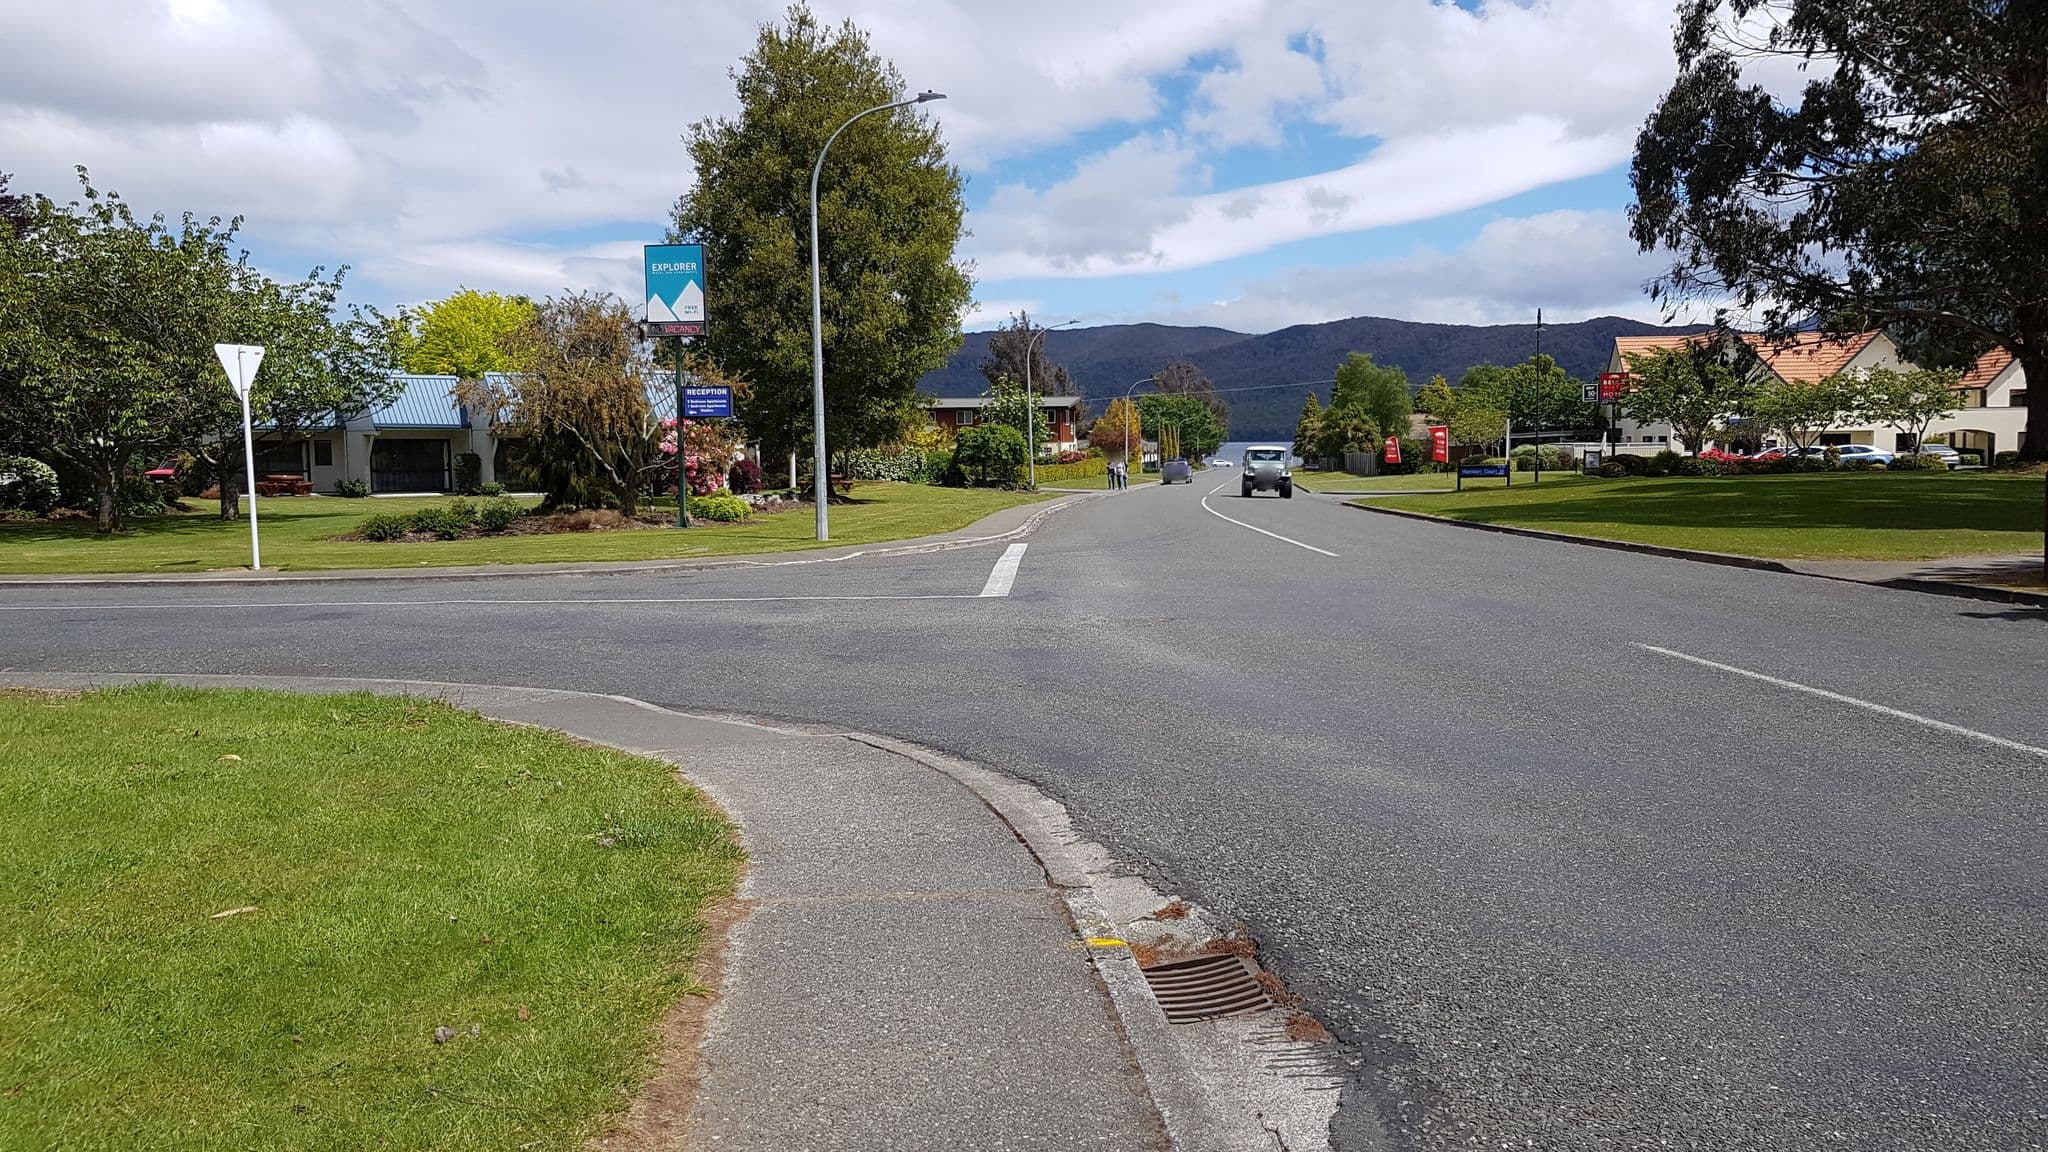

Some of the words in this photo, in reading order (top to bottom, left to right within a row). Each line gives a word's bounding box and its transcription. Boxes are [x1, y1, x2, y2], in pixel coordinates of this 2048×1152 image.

[652, 262, 697, 271] EXPLORER
[664, 325, 701, 333] VACANCY
[687, 388, 728, 396] RECEPTION
